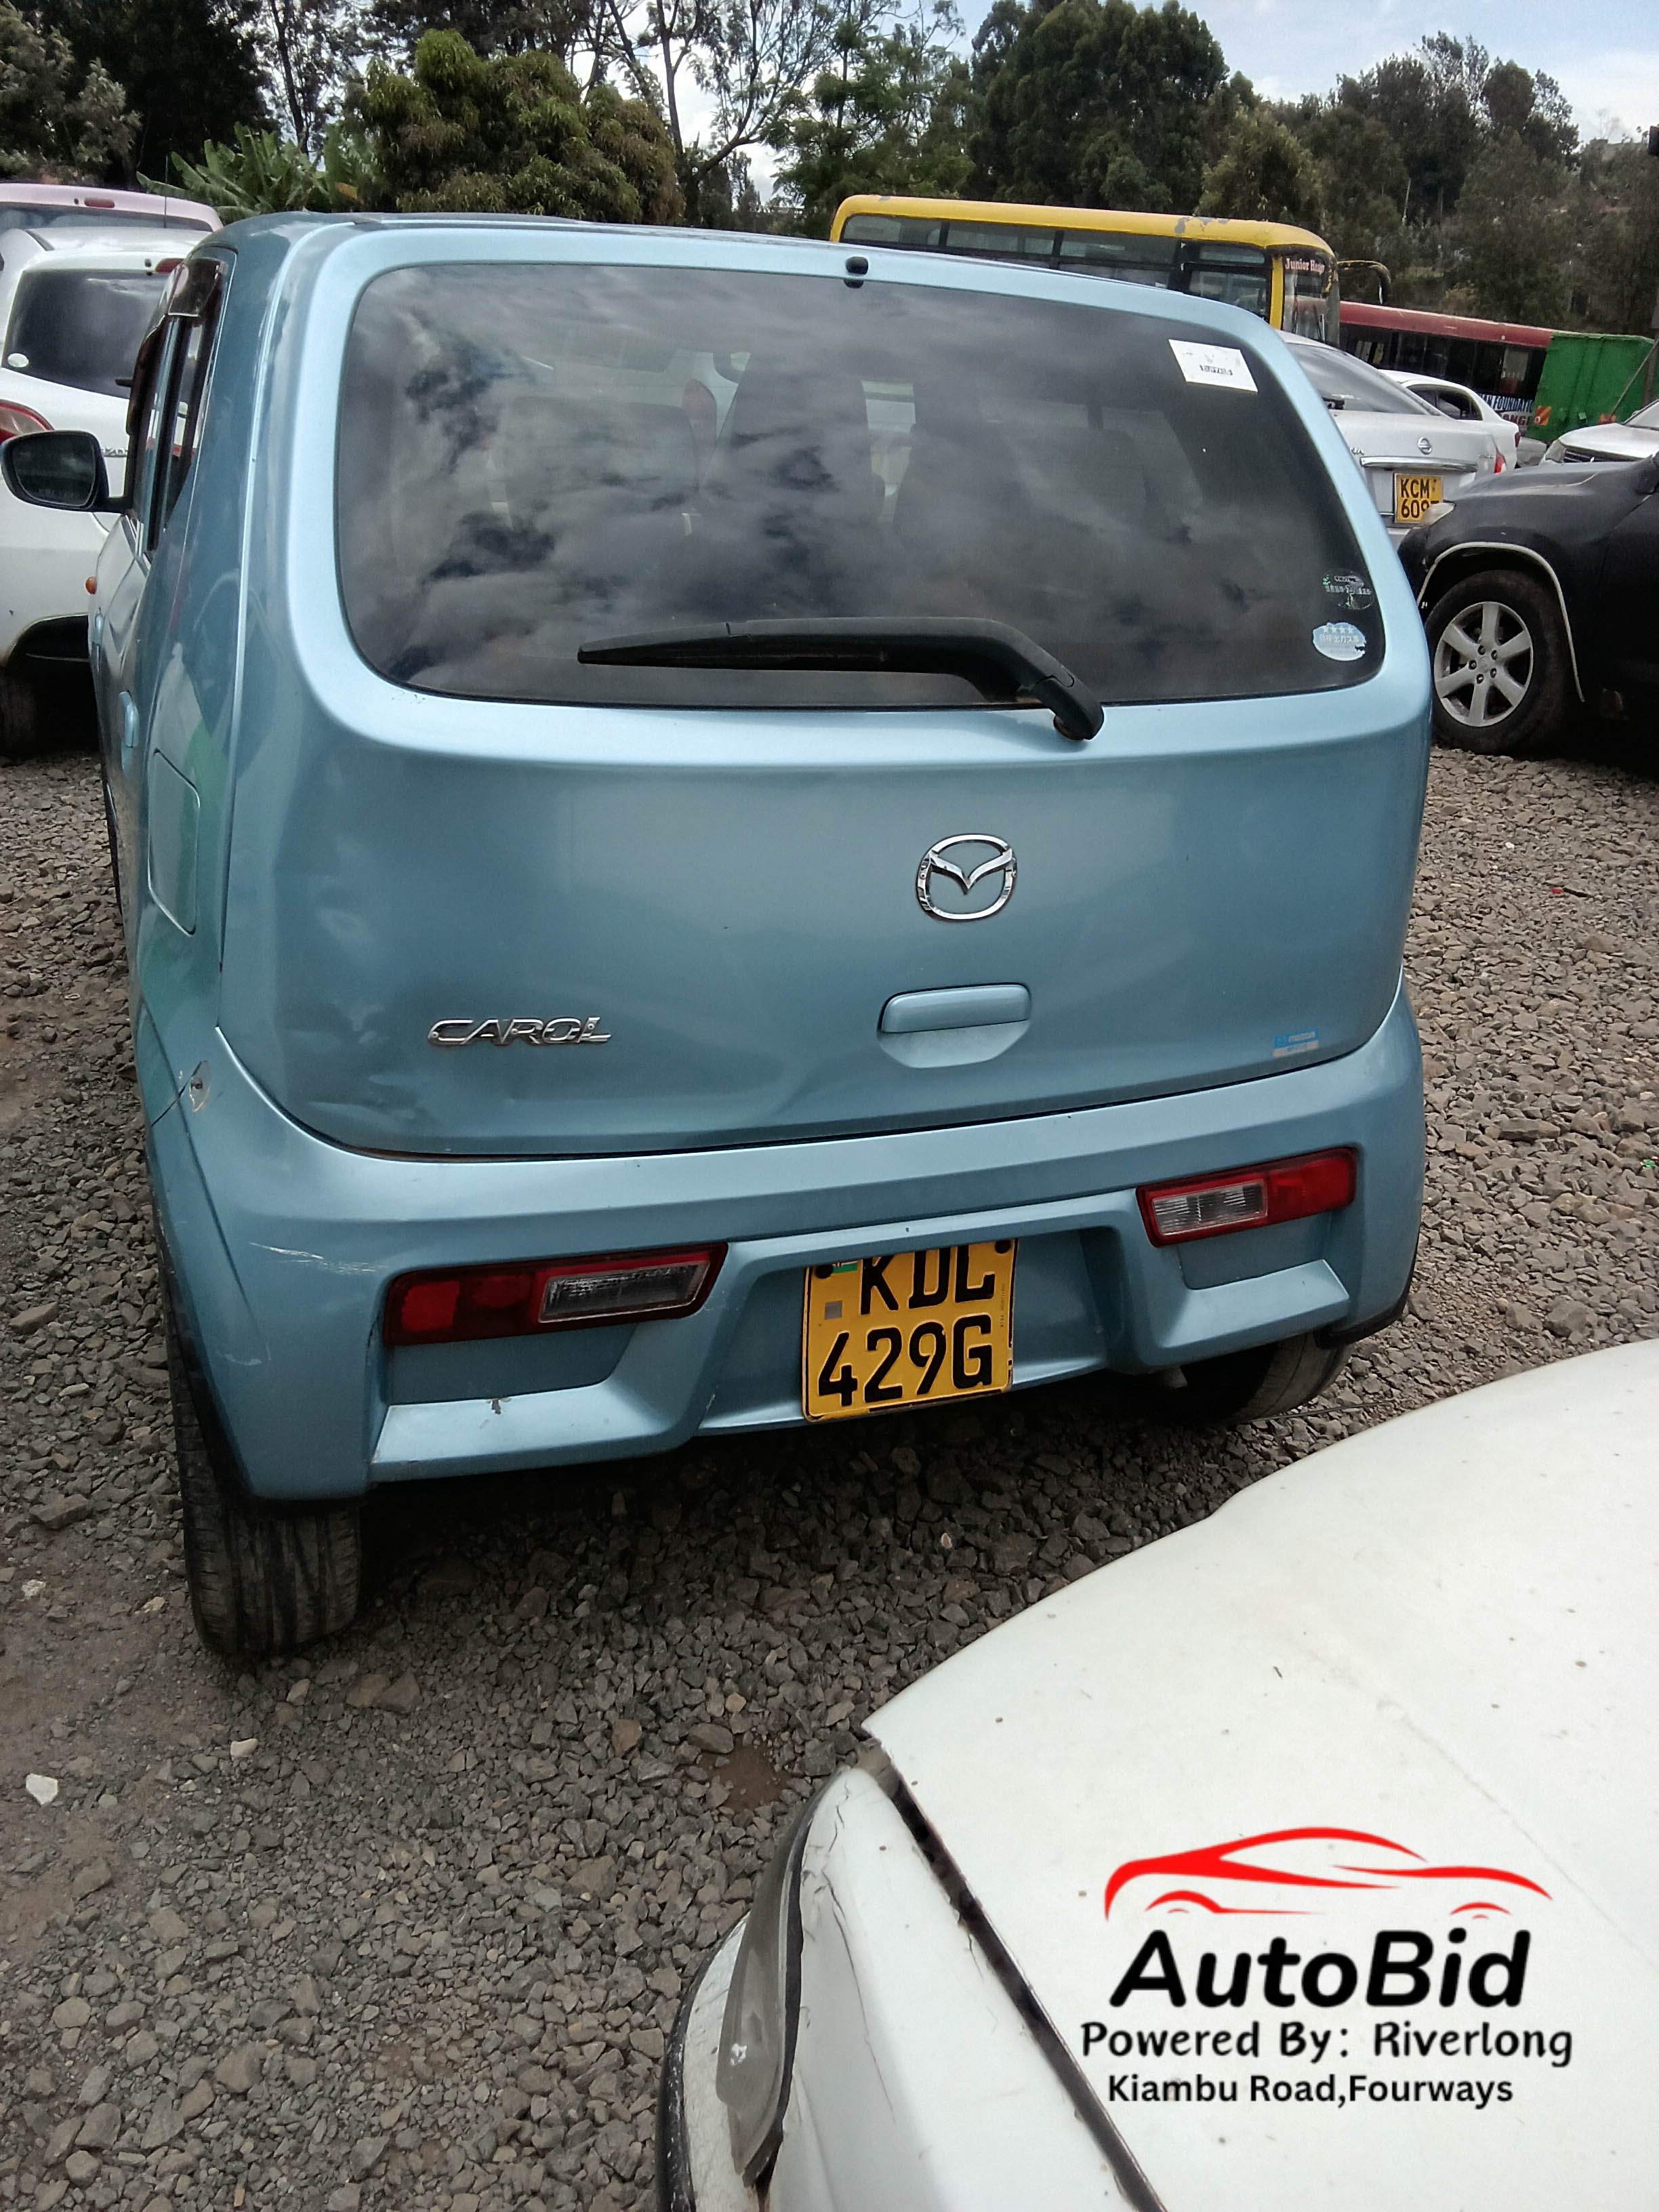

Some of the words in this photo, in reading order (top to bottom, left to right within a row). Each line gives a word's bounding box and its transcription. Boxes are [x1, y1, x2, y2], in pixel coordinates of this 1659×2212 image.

[1285, 258, 1309, 272] Junior
[1401, 478, 1430, 499] KCM
[1401, 499, 1439, 518] 609
[427, 1017, 611, 1046] CAROL
[861, 1246, 996, 1315] KDL
[818, 1314, 992, 1407] 429G
